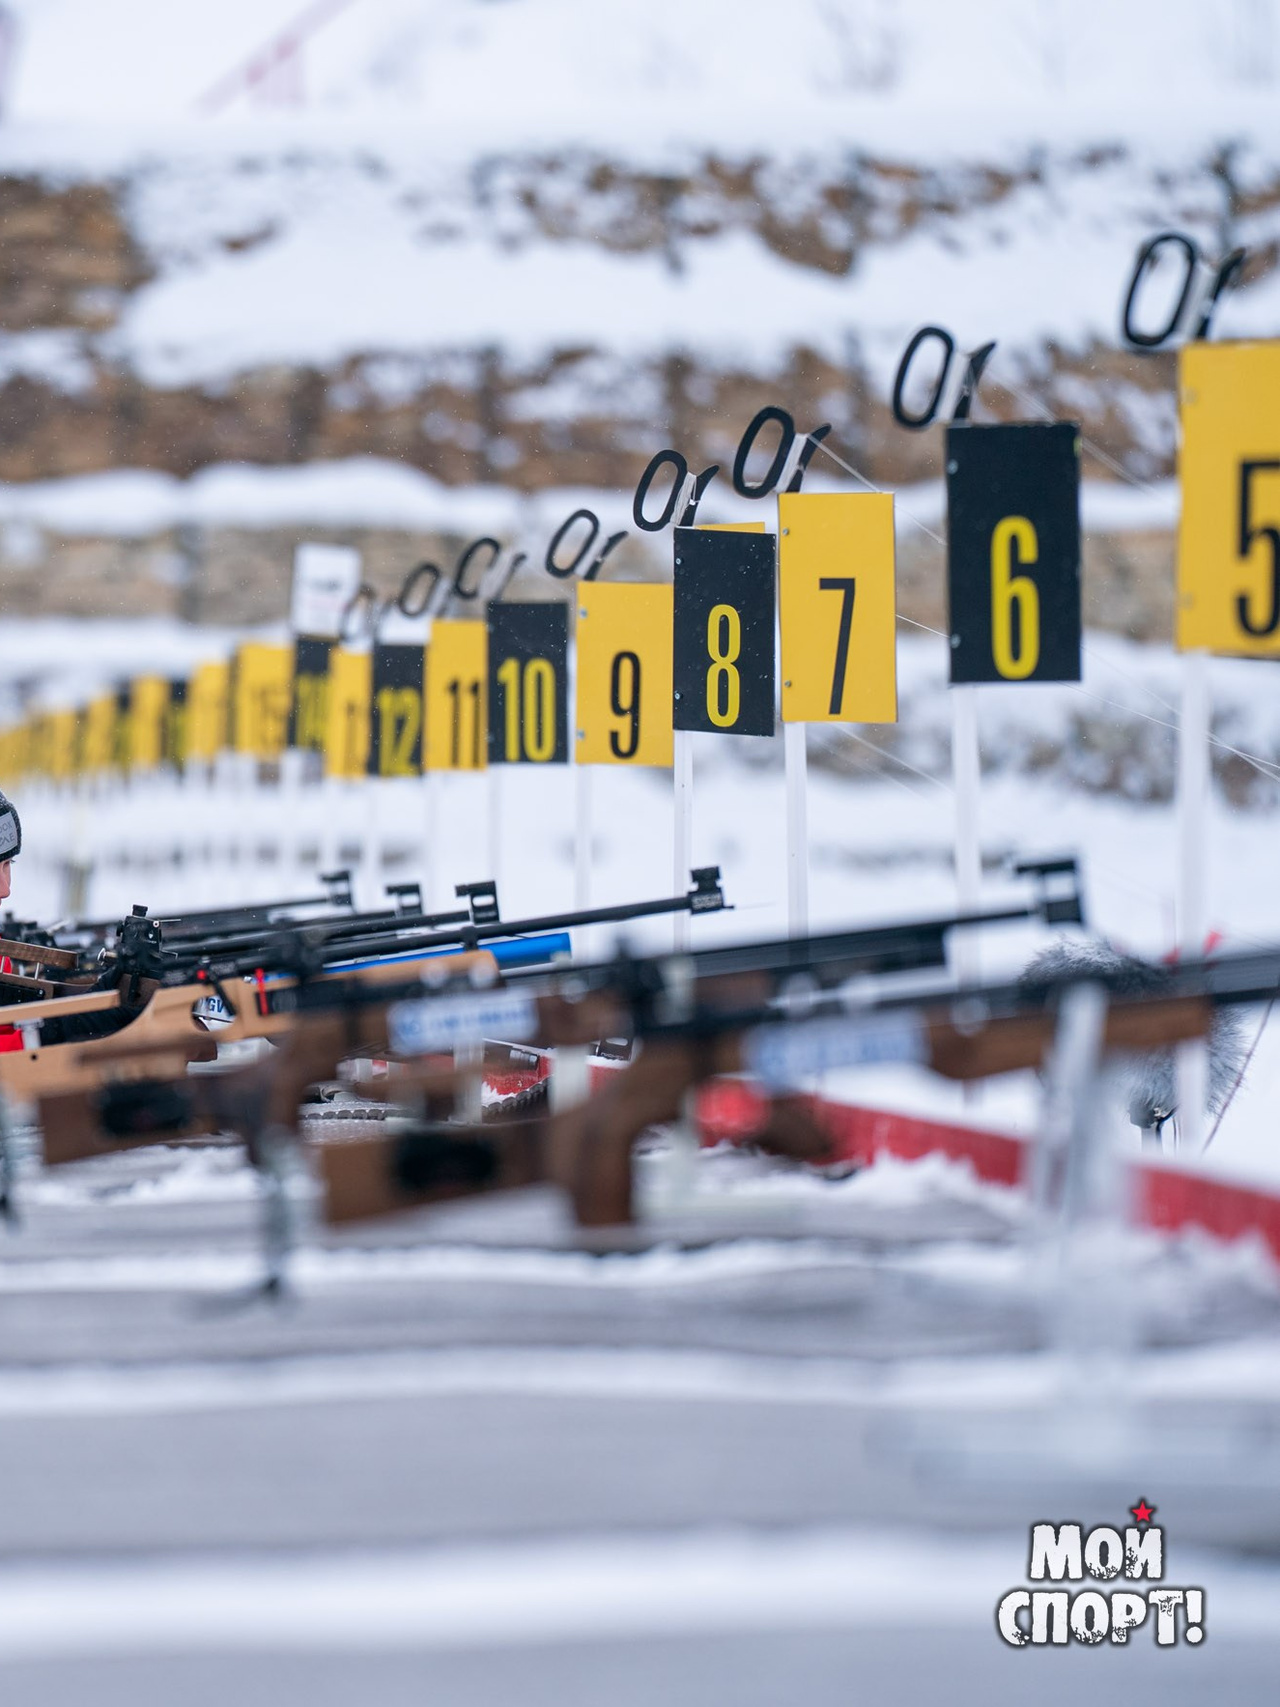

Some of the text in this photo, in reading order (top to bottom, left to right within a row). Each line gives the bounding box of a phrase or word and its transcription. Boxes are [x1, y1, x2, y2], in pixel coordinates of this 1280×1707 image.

[990, 515, 1040, 680] 6
[1236, 458, 1280, 637] 5
[609, 650, 641, 759] 9
[706, 603, 741, 728] 8
[819, 577, 856, 716] 7
[377, 687, 422, 777] 12
[448, 678, 480, 767] 11
[497, 657, 557, 763] 10
